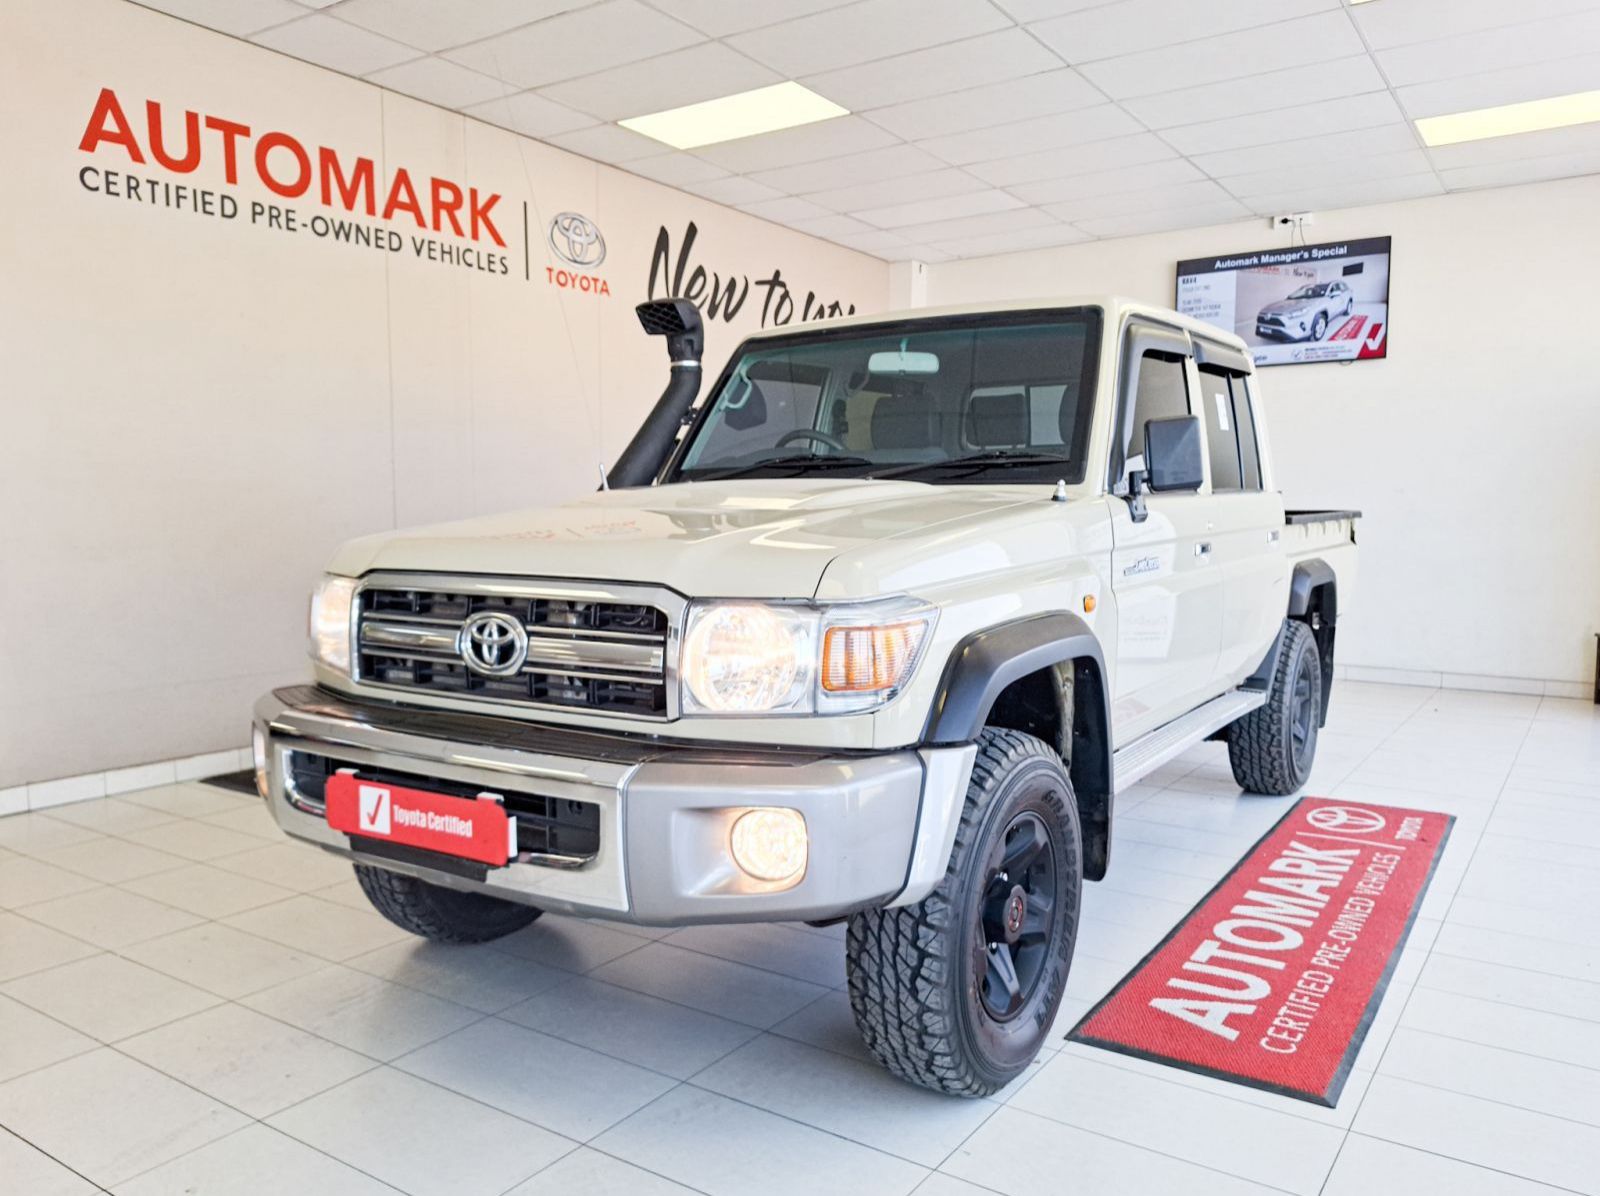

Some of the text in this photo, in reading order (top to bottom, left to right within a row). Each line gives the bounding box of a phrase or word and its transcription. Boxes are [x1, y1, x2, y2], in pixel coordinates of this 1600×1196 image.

[78, 87, 508, 248] AUTOMARK
[78, 165, 510, 276] CERTIFIED PRE-OWNED VEHICLES
[546, 266, 611, 297] TOYOTA
[648, 220, 794, 329] New to
[1214, 255, 1259, 270] Automark
[1260, 248, 1309, 265] Manager's
[1311, 245, 1348, 260] Special
[393, 804, 473, 838] Toyota Certified
[1148, 840, 1361, 1042] AUTOMARK
[1259, 852, 1401, 1054] CERTIFIED PRE-OWNED VEHICLES
